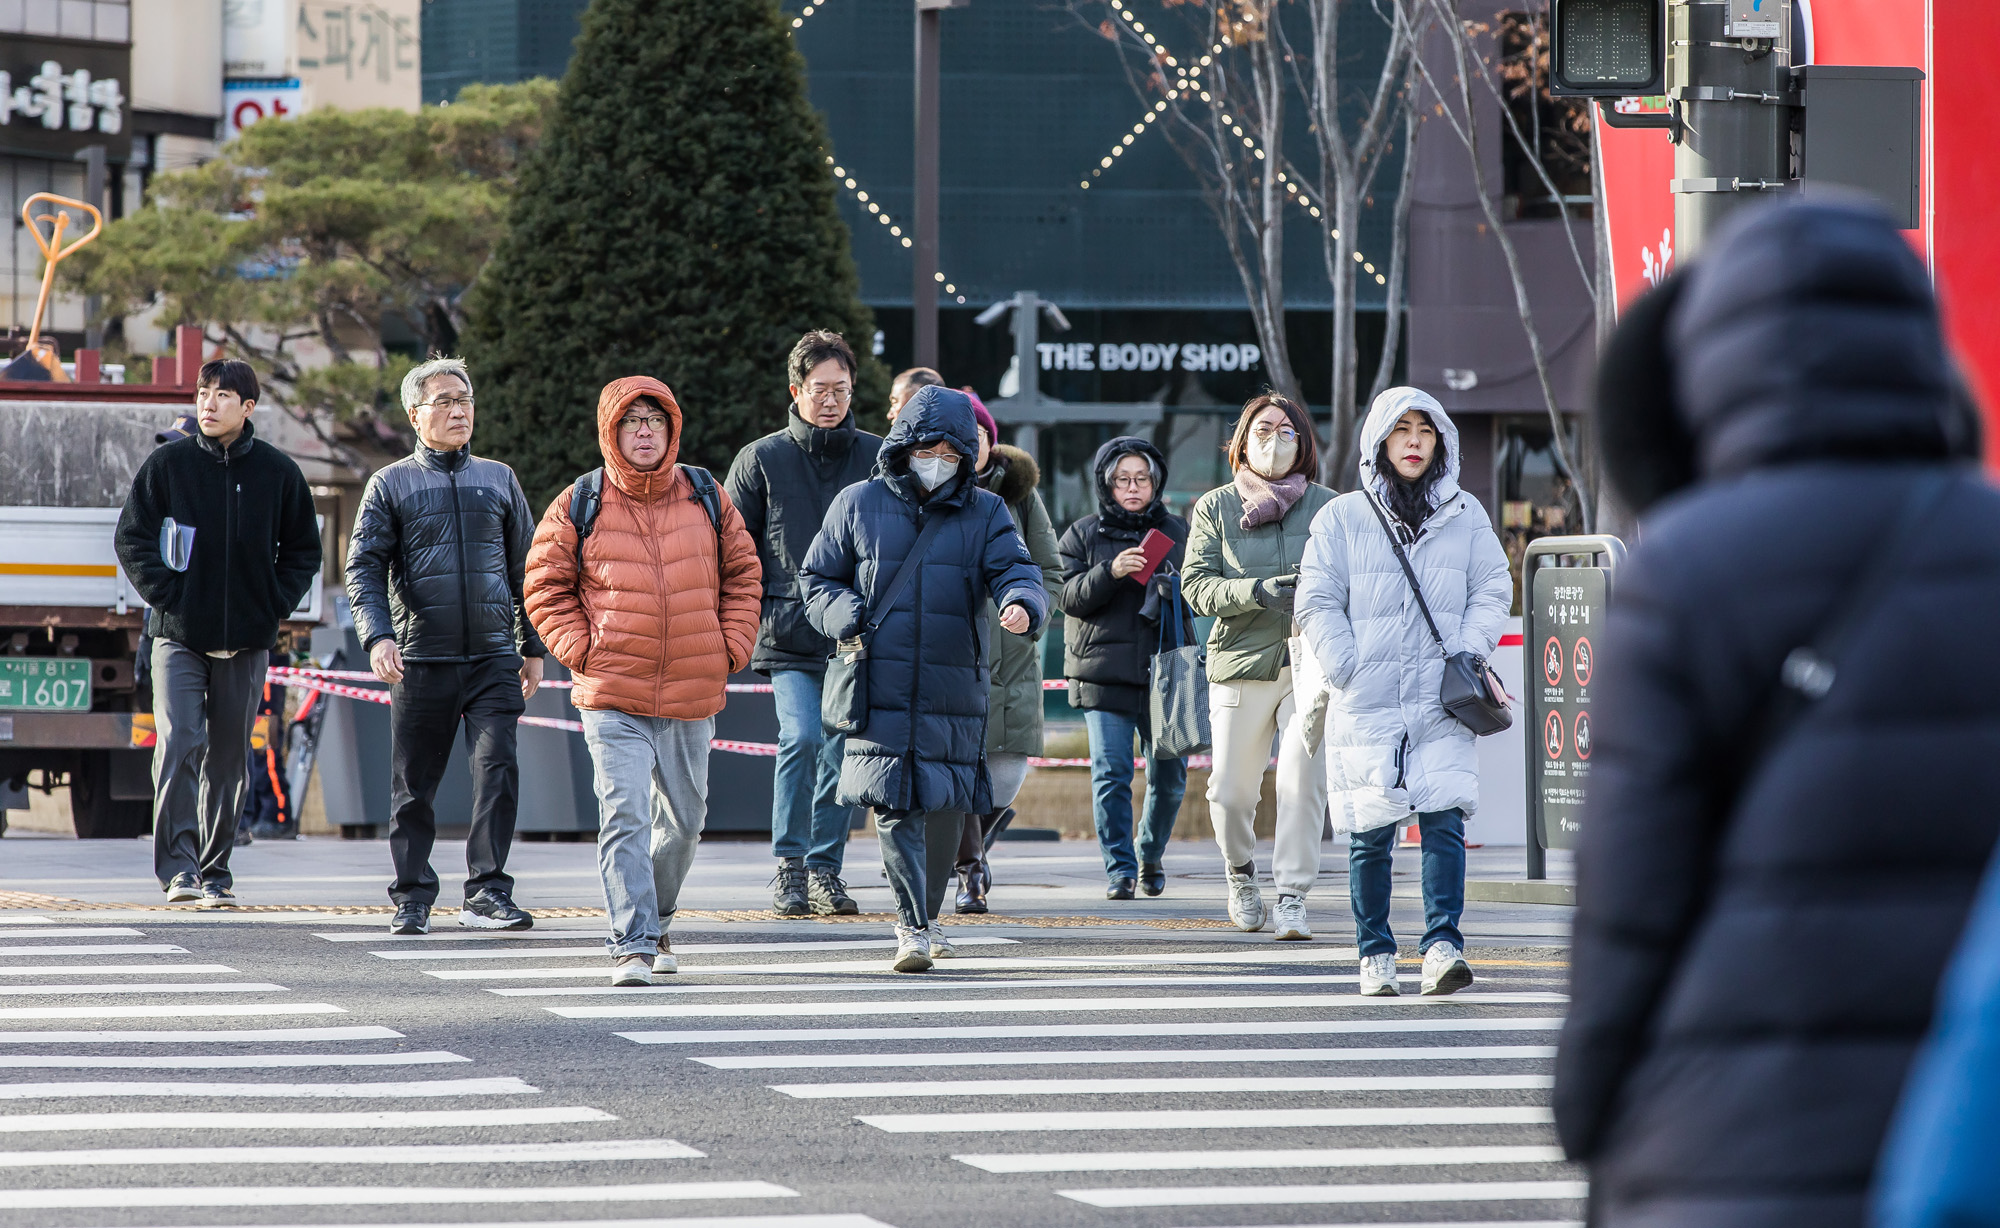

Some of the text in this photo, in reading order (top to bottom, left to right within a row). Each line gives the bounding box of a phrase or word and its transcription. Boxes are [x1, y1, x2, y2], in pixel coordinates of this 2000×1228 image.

[1036, 343, 1261, 371] THE BODY SHOP
[1554, 586, 1584, 600] 광화문광장
[14, 660, 66, 677] 서울 81
[22, 679, 86, 707] 1607
